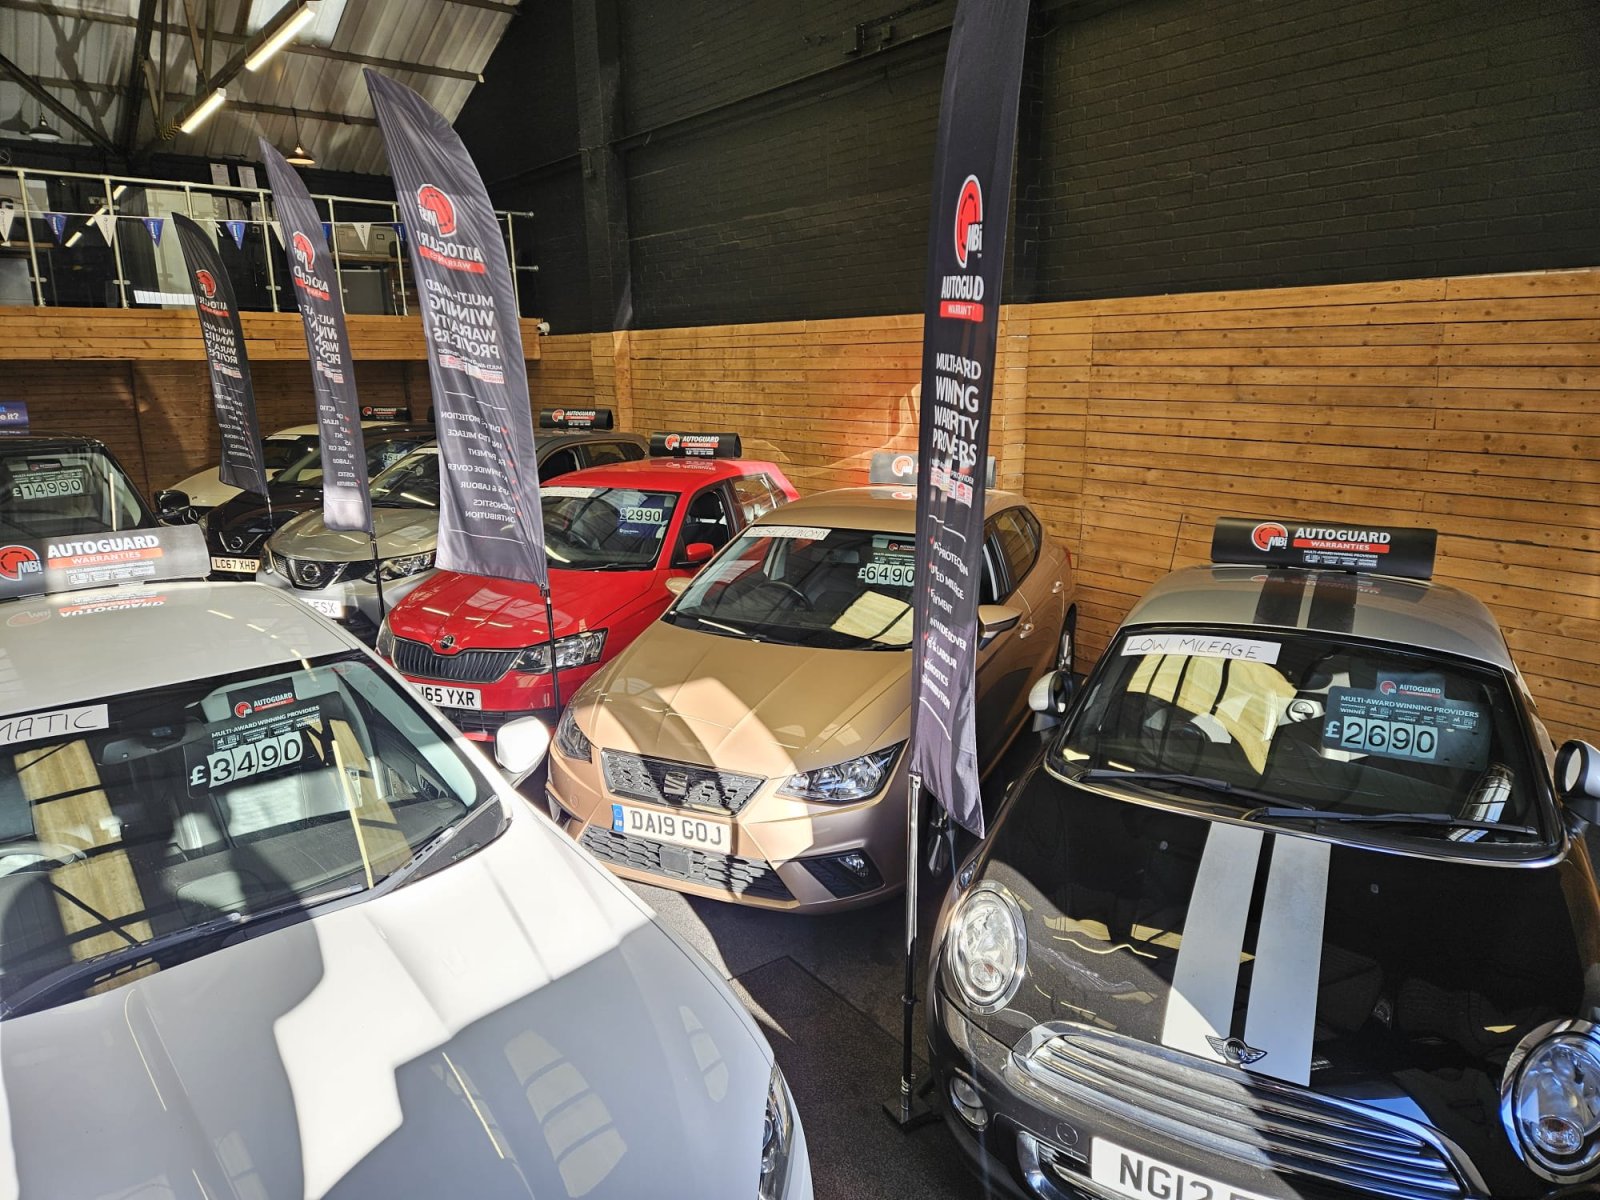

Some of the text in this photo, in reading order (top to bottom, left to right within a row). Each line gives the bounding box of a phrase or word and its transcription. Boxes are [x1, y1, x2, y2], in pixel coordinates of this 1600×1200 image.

[941, 275, 985, 301] AUTOGUD
[1294, 527, 1391, 544] AUTOGUARD
[48, 534, 159, 559] AUTOGUARD
[1311, 541, 1370, 551] WARRANTIES
[71, 551, 142, 565] WARRANTIES
[215, 559, 256, 571] LC67 XHB
[17, 560, 42, 575] MBi
[1127, 638, 1261, 660] LOW MILEAGE
[447, 689, 475, 706] YXR
[1400, 684, 1441, 694] AUTOGUARD
[253, 692, 293, 707] AUTOGUARD
[1340, 695, 1396, 707] MULTI-AWARD
[1395, 702, 1433, 713] WINNING
[1434, 706, 1480, 718] PROVIDERS
[1340, 707, 1366, 715] WINNER
[211, 705, 320, 739] MULTI-AWARD WINNING PROVIDERS
[1325, 721, 1435, 753] £2690
[190, 738, 301, 787] £3490
[630, 810, 722, 846] DA19 GOJ
